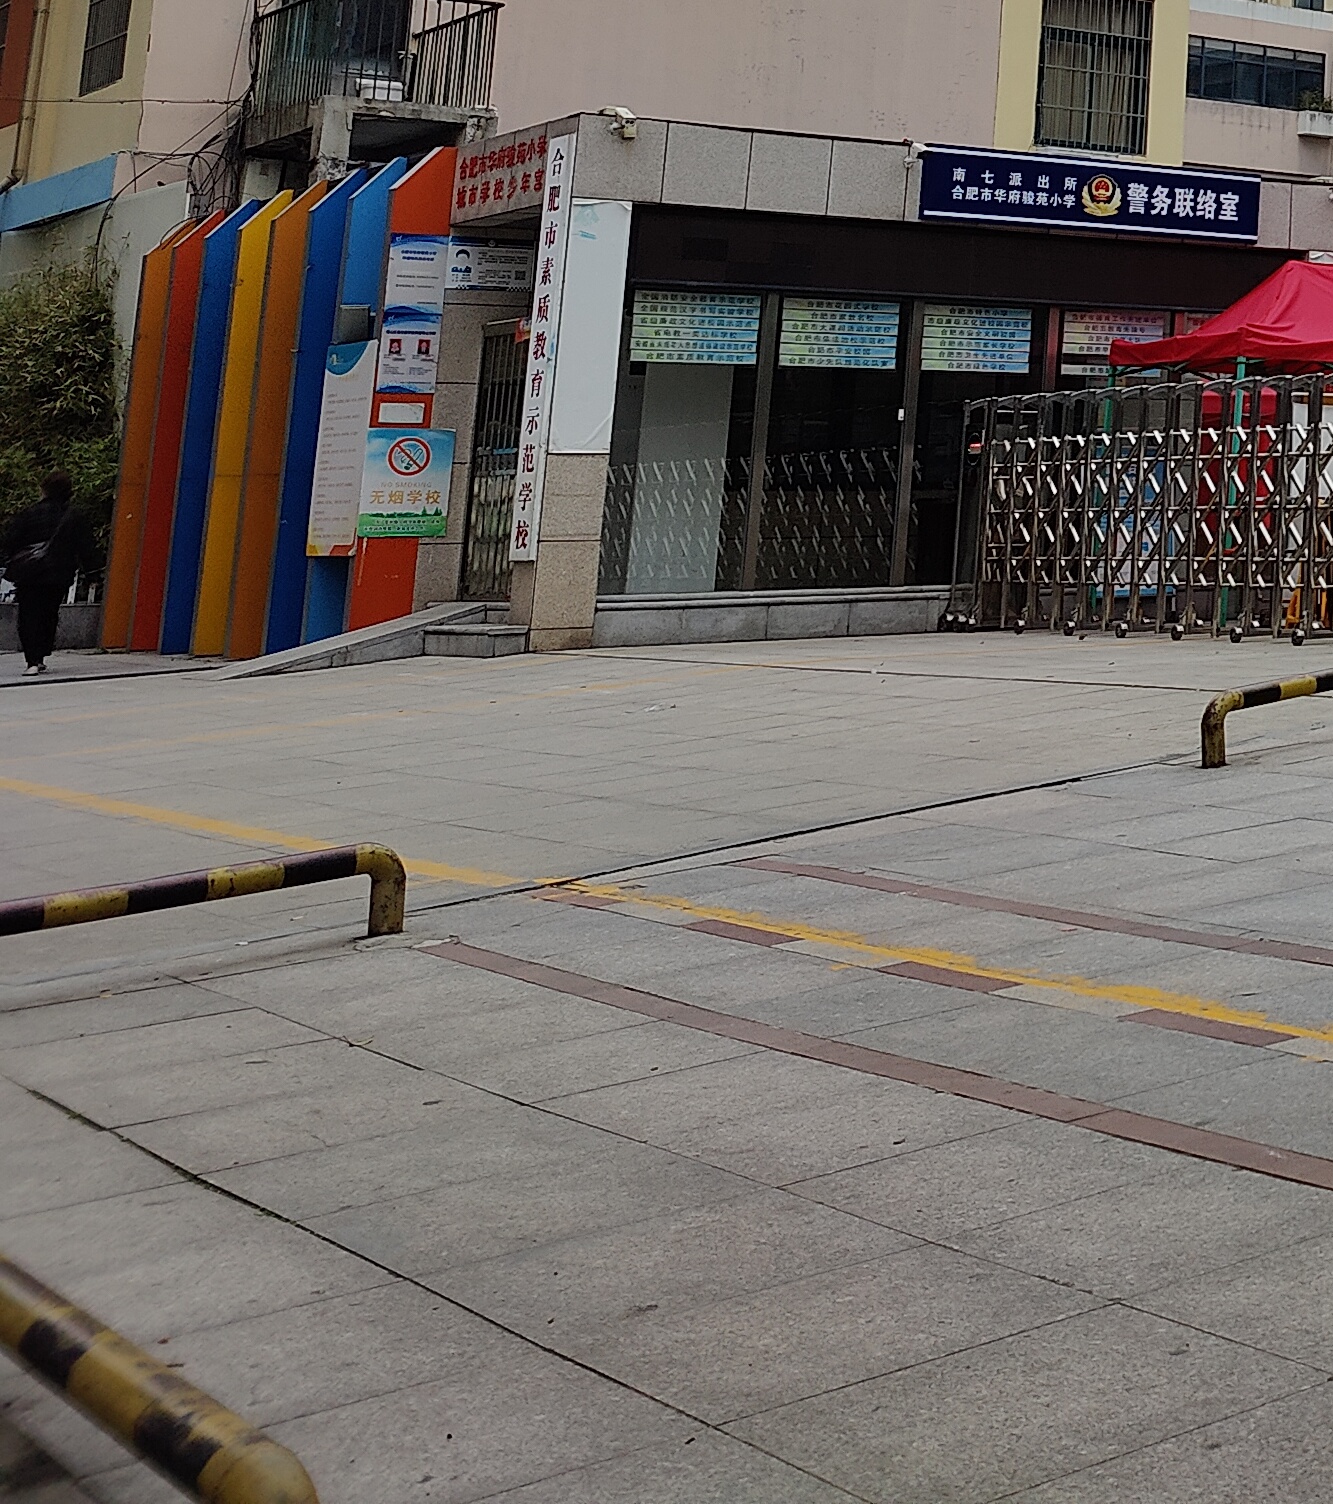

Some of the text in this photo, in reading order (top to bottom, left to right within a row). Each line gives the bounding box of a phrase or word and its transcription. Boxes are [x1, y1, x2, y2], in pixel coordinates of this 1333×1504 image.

[952, 167, 1078, 192] 南七派出所
[951, 184, 1077, 209] 合肥市华府骏苑小学
[1126, 182, 1241, 223] 警务联络室
[514, 147, 565, 552] 合肥市素质教育示范学校
[369, 489, 442, 505] 无烟学校
